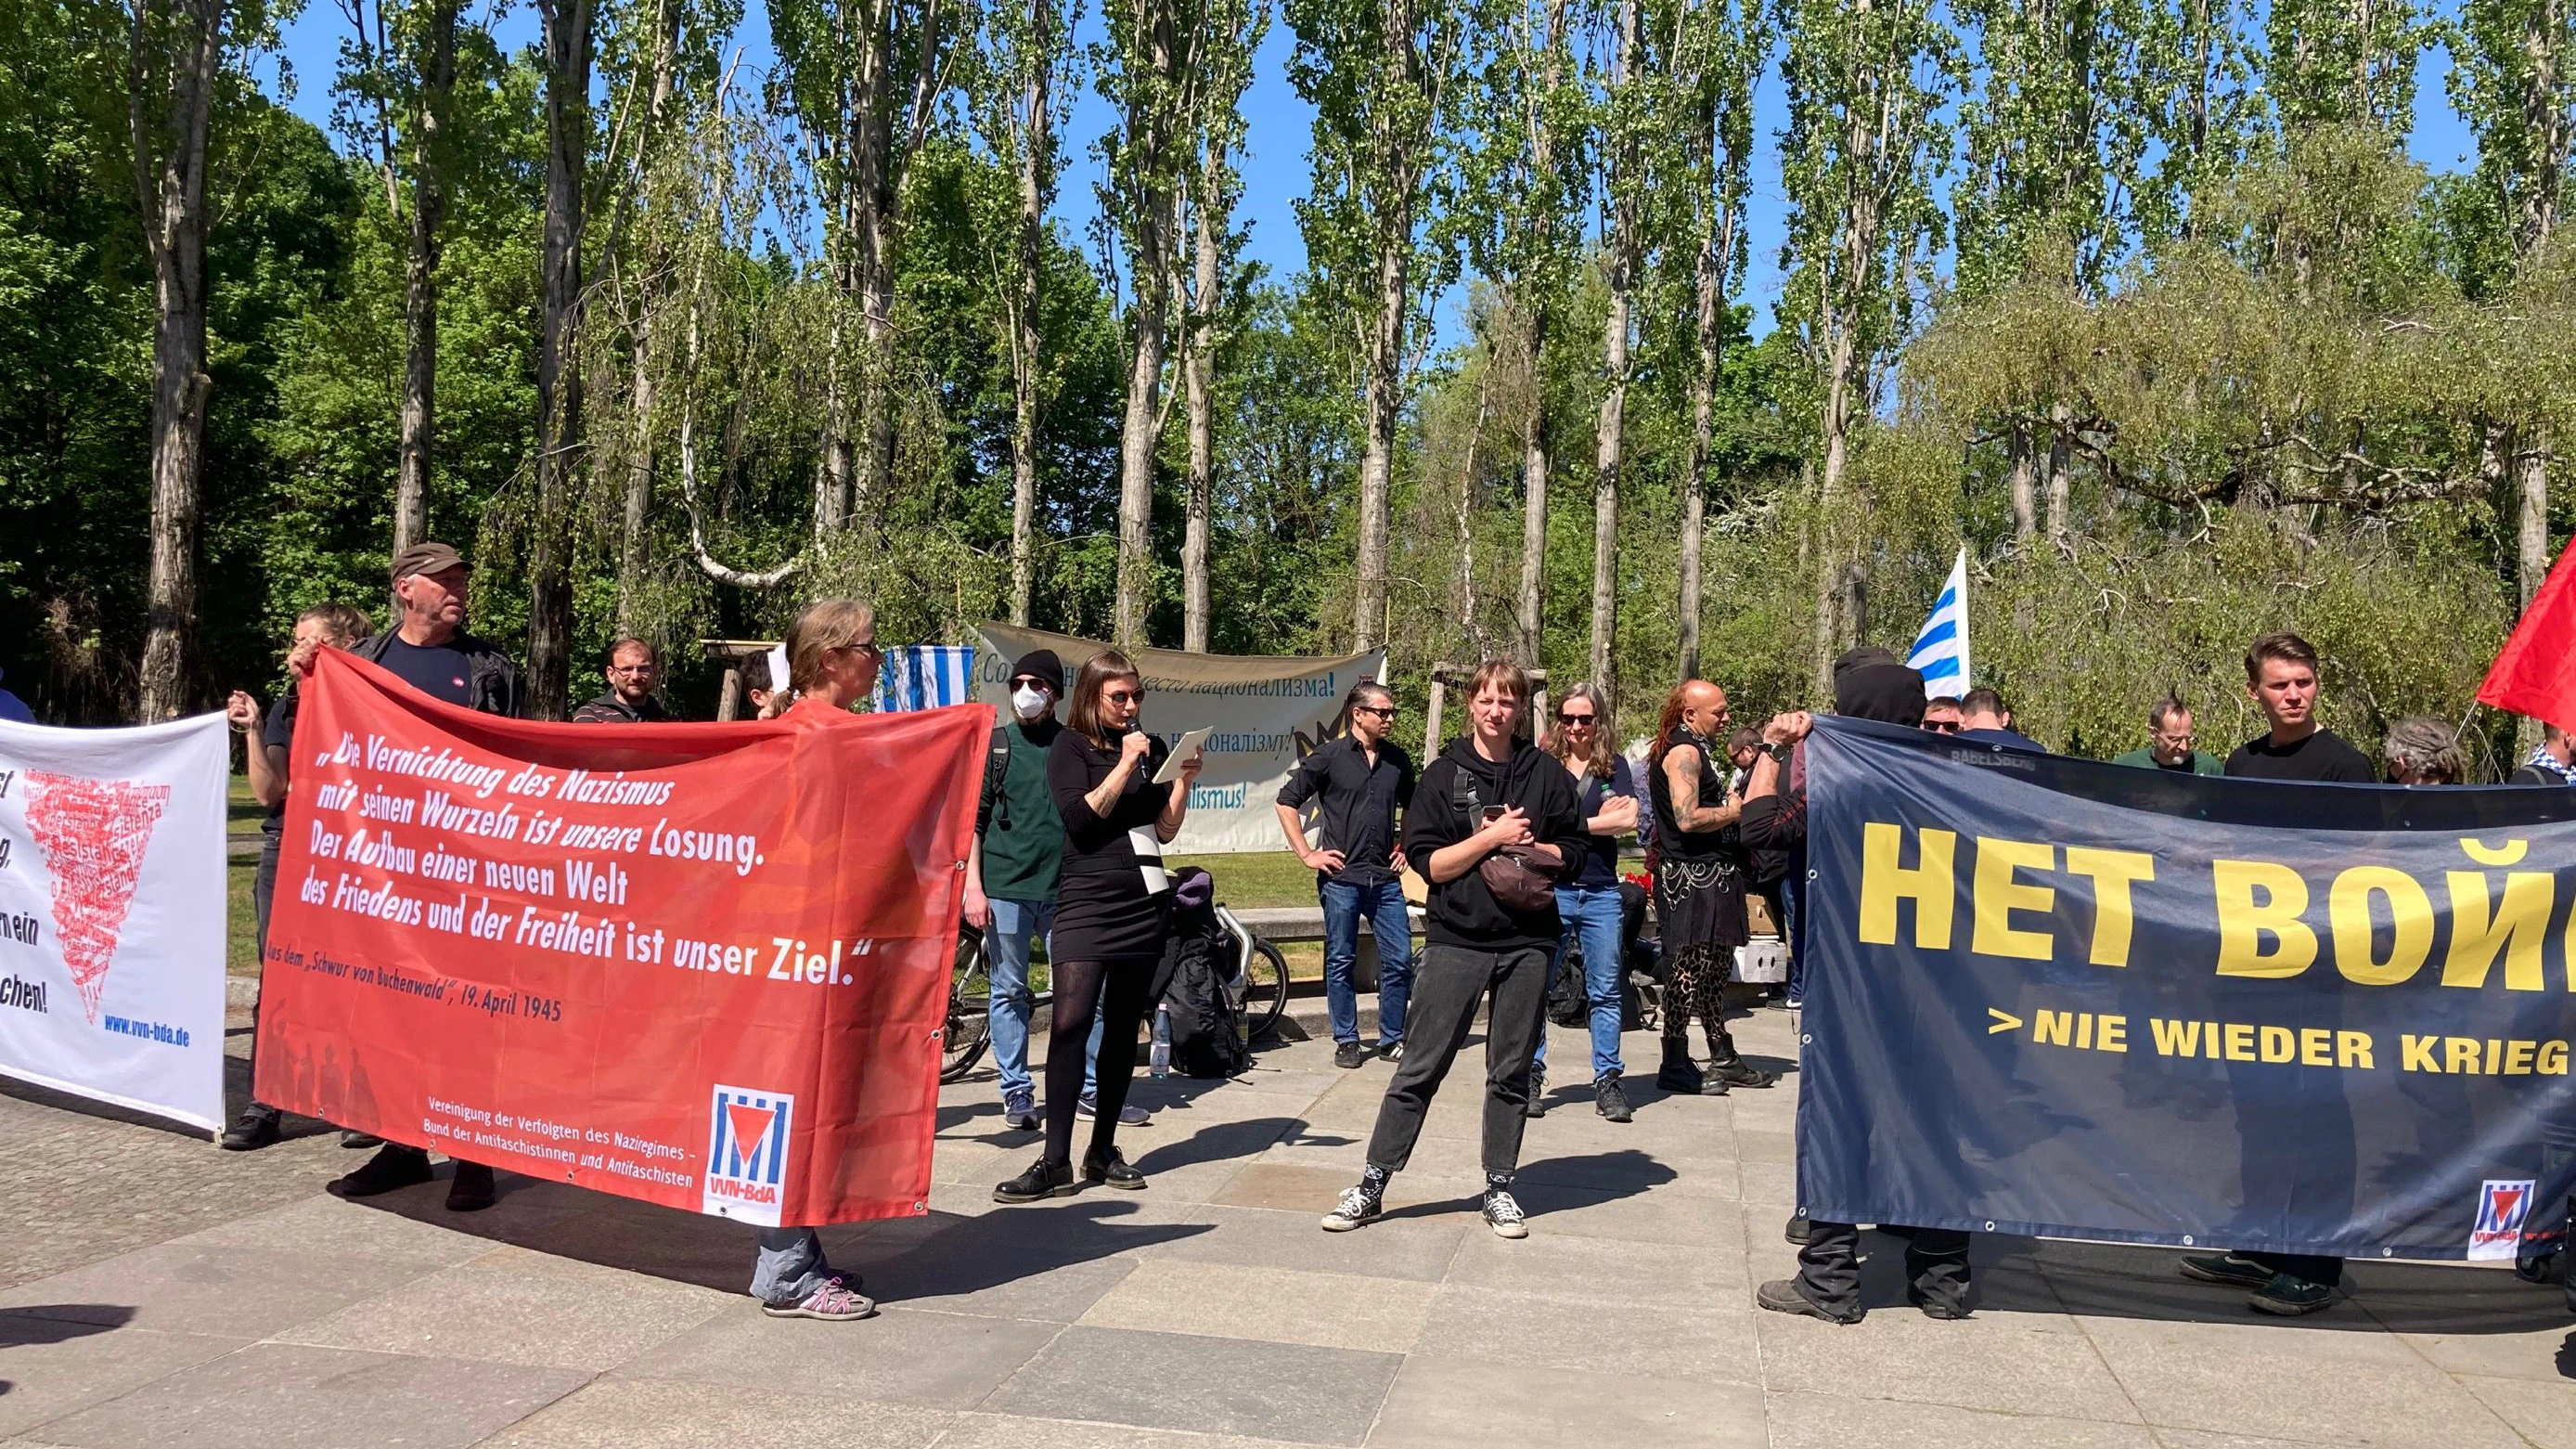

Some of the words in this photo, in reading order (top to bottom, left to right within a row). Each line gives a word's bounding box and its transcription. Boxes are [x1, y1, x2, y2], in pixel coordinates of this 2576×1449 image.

[367, 734, 506, 798] Vernichtung
[508, 763, 557, 798] des
[557, 769, 676, 806] Nazismus
[310, 820, 343, 860] Der
[344, 828, 416, 874] Aufbau
[421, 843, 477, 885] einer
[485, 860, 554, 896] neuen
[566, 859, 627, 905] Welt
[316, 780, 358, 812] mit
[359, 784, 415, 824] seinen
[421, 790, 520, 841] Wurzeln
[522, 809, 564, 846] ist
[560, 823, 643, 853] unsere
[650, 818, 765, 877] Losung.
[12, 912, 39, 946] ein
[301, 864, 328, 906] des
[332, 873, 422, 925] Friedens
[428, 894, 466, 934] und
[470, 897, 512, 941] der
[515, 906, 615, 958] Freiheit
[626, 921, 665, 964] ist
[674, 938, 758, 976] unser
[1860, 822, 2155, 967] НЕТ
[284, 943, 304, 967] dem
[354, 966, 375, 984] von
[460, 984, 477, 1007] 19.
[482, 989, 517, 1017] April
[524, 996, 562, 1022] 1945
[105, 1014, 190, 1048] www.vvn-bda.de
[2150, 1018, 2376, 1069] WIEDER
[2401, 1034, 2570, 1076] KRIEG
[423, 1119, 450, 1137] Bund
[453, 1126, 471, 1142] der
[475, 1132, 575, 1164] Antifaschistinnen
[580, 1154, 604, 1170] und
[607, 1158, 693, 1188] Antifaschisten
[428, 1096, 492, 1126] Vereinigung
[495, 1111, 514, 1128] der
[517, 1116, 580, 1140] Verfolgten
[586, 1127, 610, 1144] des
[614, 1132, 684, 1160] Naziregimes
[710, 1177, 778, 1205] VVN-BdA
